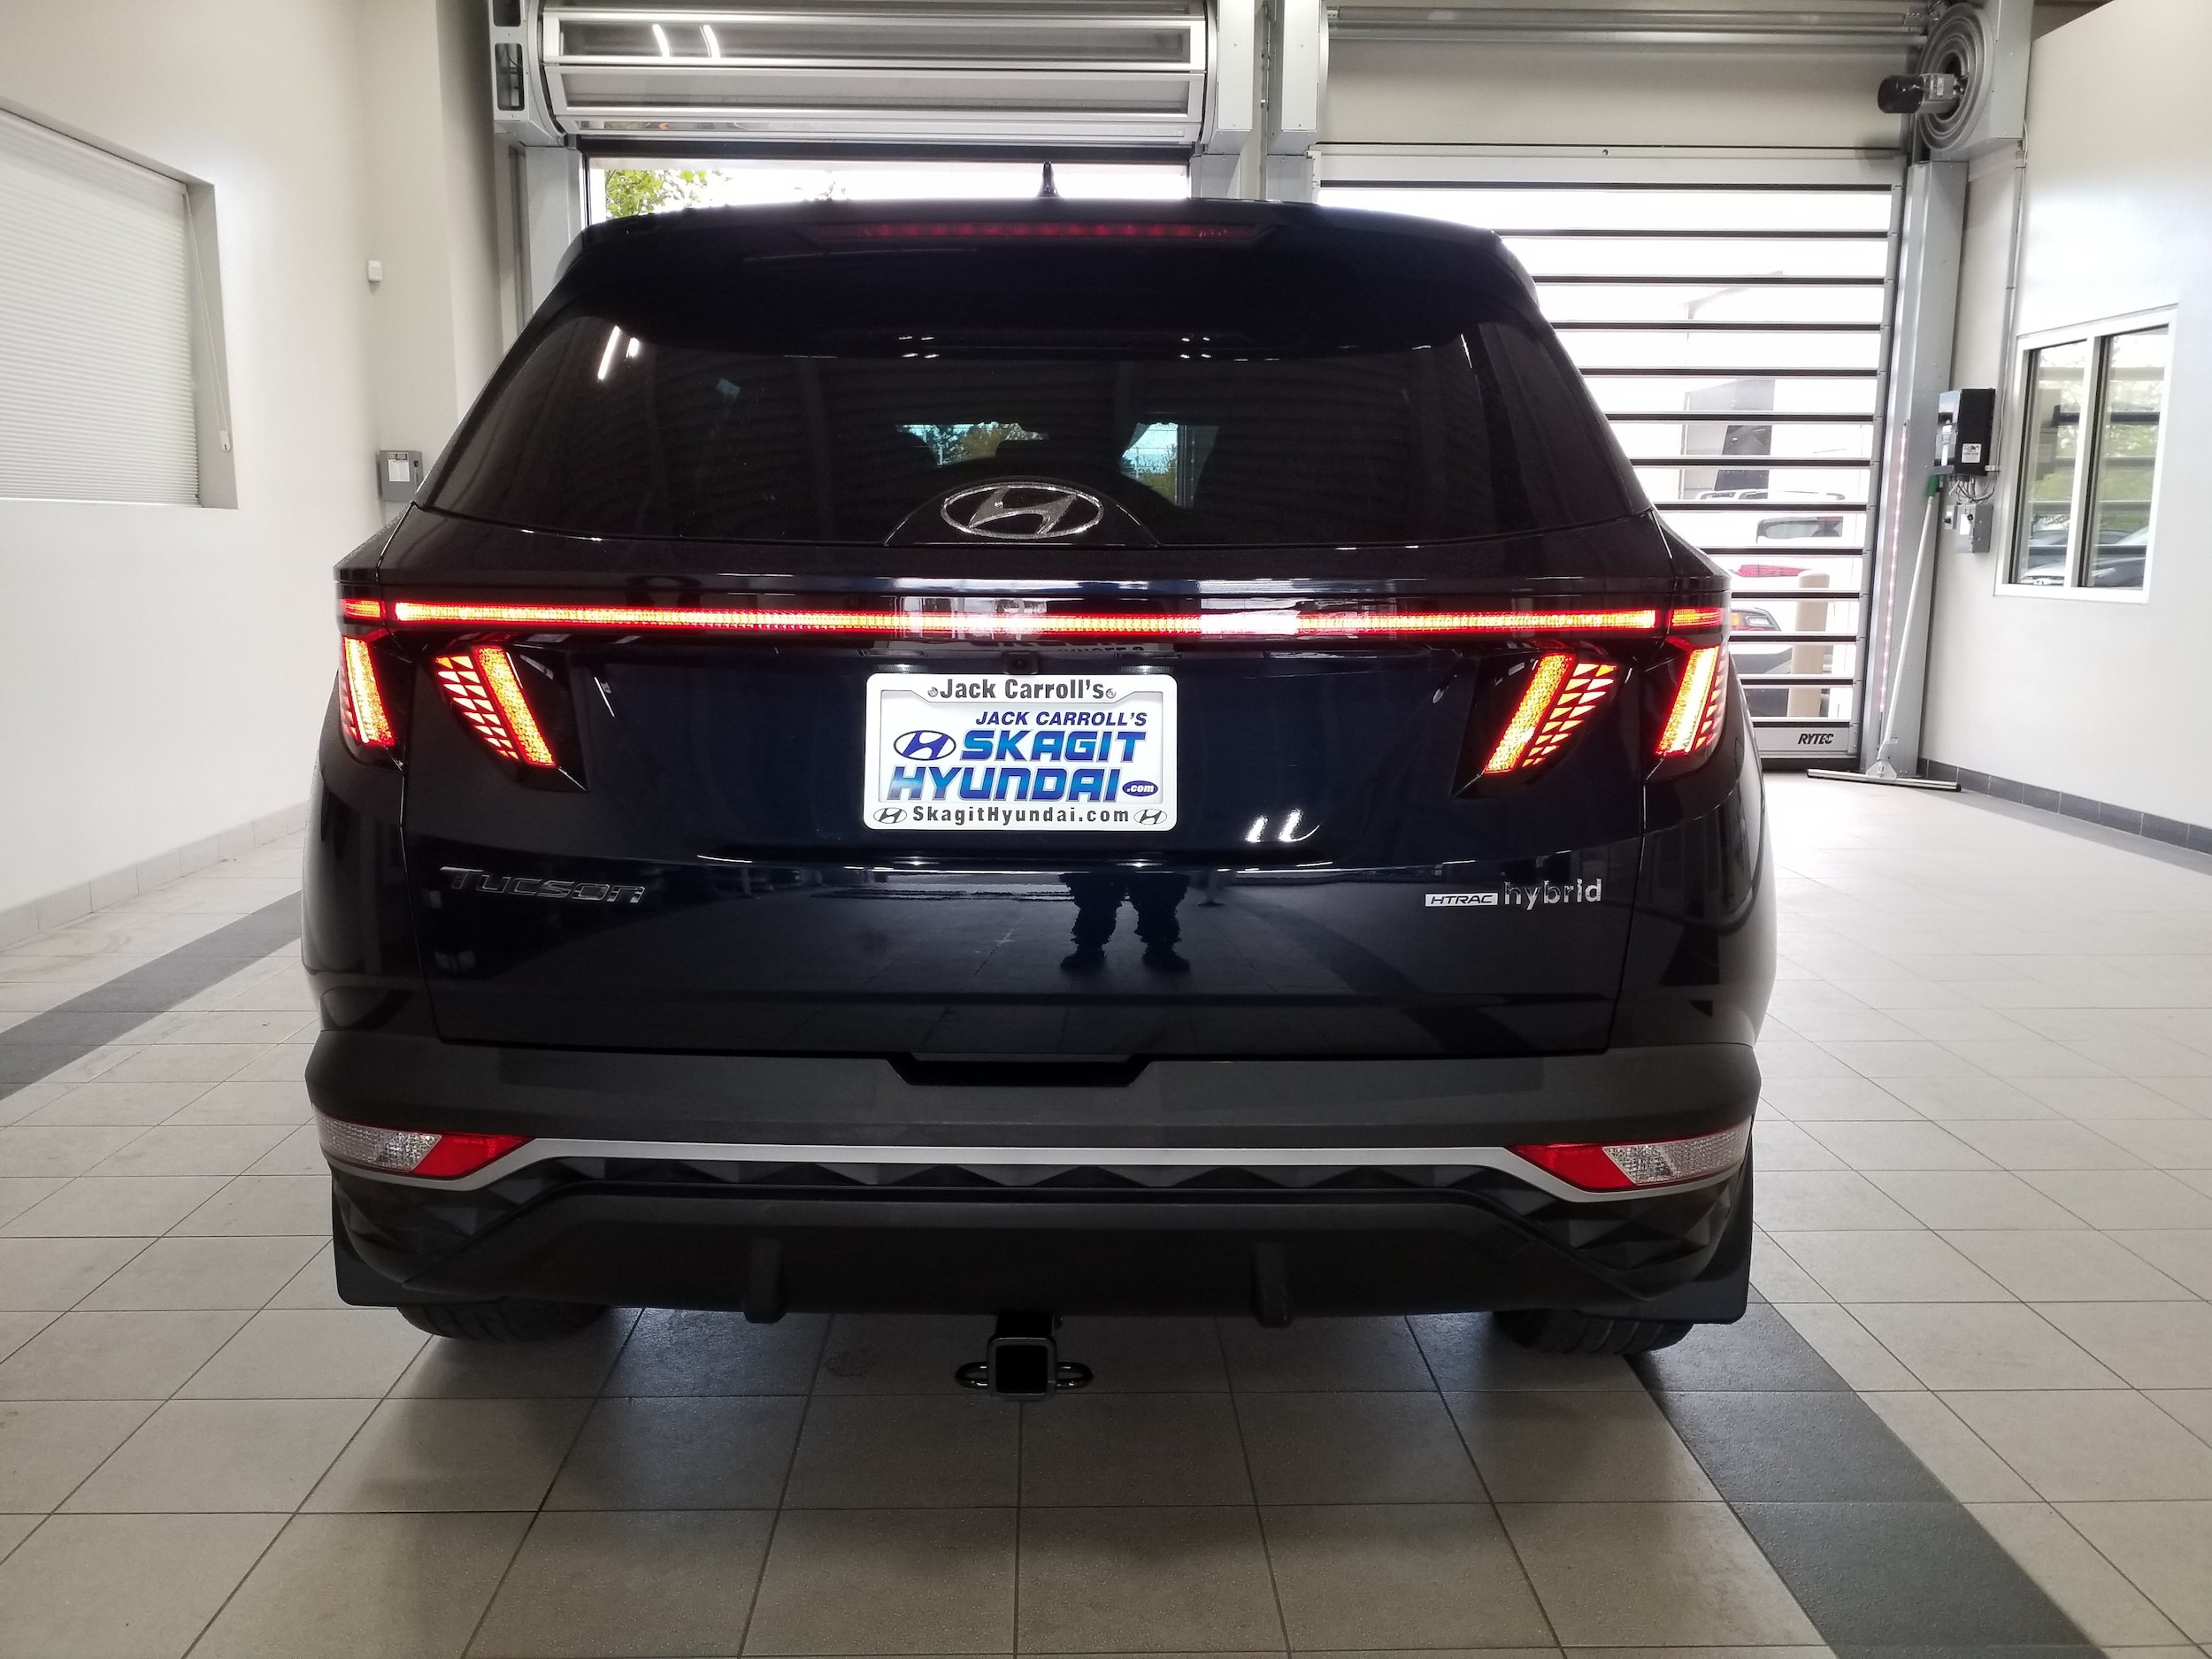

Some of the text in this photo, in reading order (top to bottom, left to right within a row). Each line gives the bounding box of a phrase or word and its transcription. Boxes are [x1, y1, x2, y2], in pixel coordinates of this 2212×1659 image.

[940, 679, 1104, 699] Jack Carroll's
[976, 711, 1147, 726] JACK CARROLL'S
[960, 730, 1147, 763] SKAGIT
[1797, 733, 1834, 744] RYTEC
[887, 765, 1120, 802] HYUNDAI
[912, 806, 1129, 826] SkagitHyundai.com
[1431, 879, 1602, 910] HTRAC hybrid
